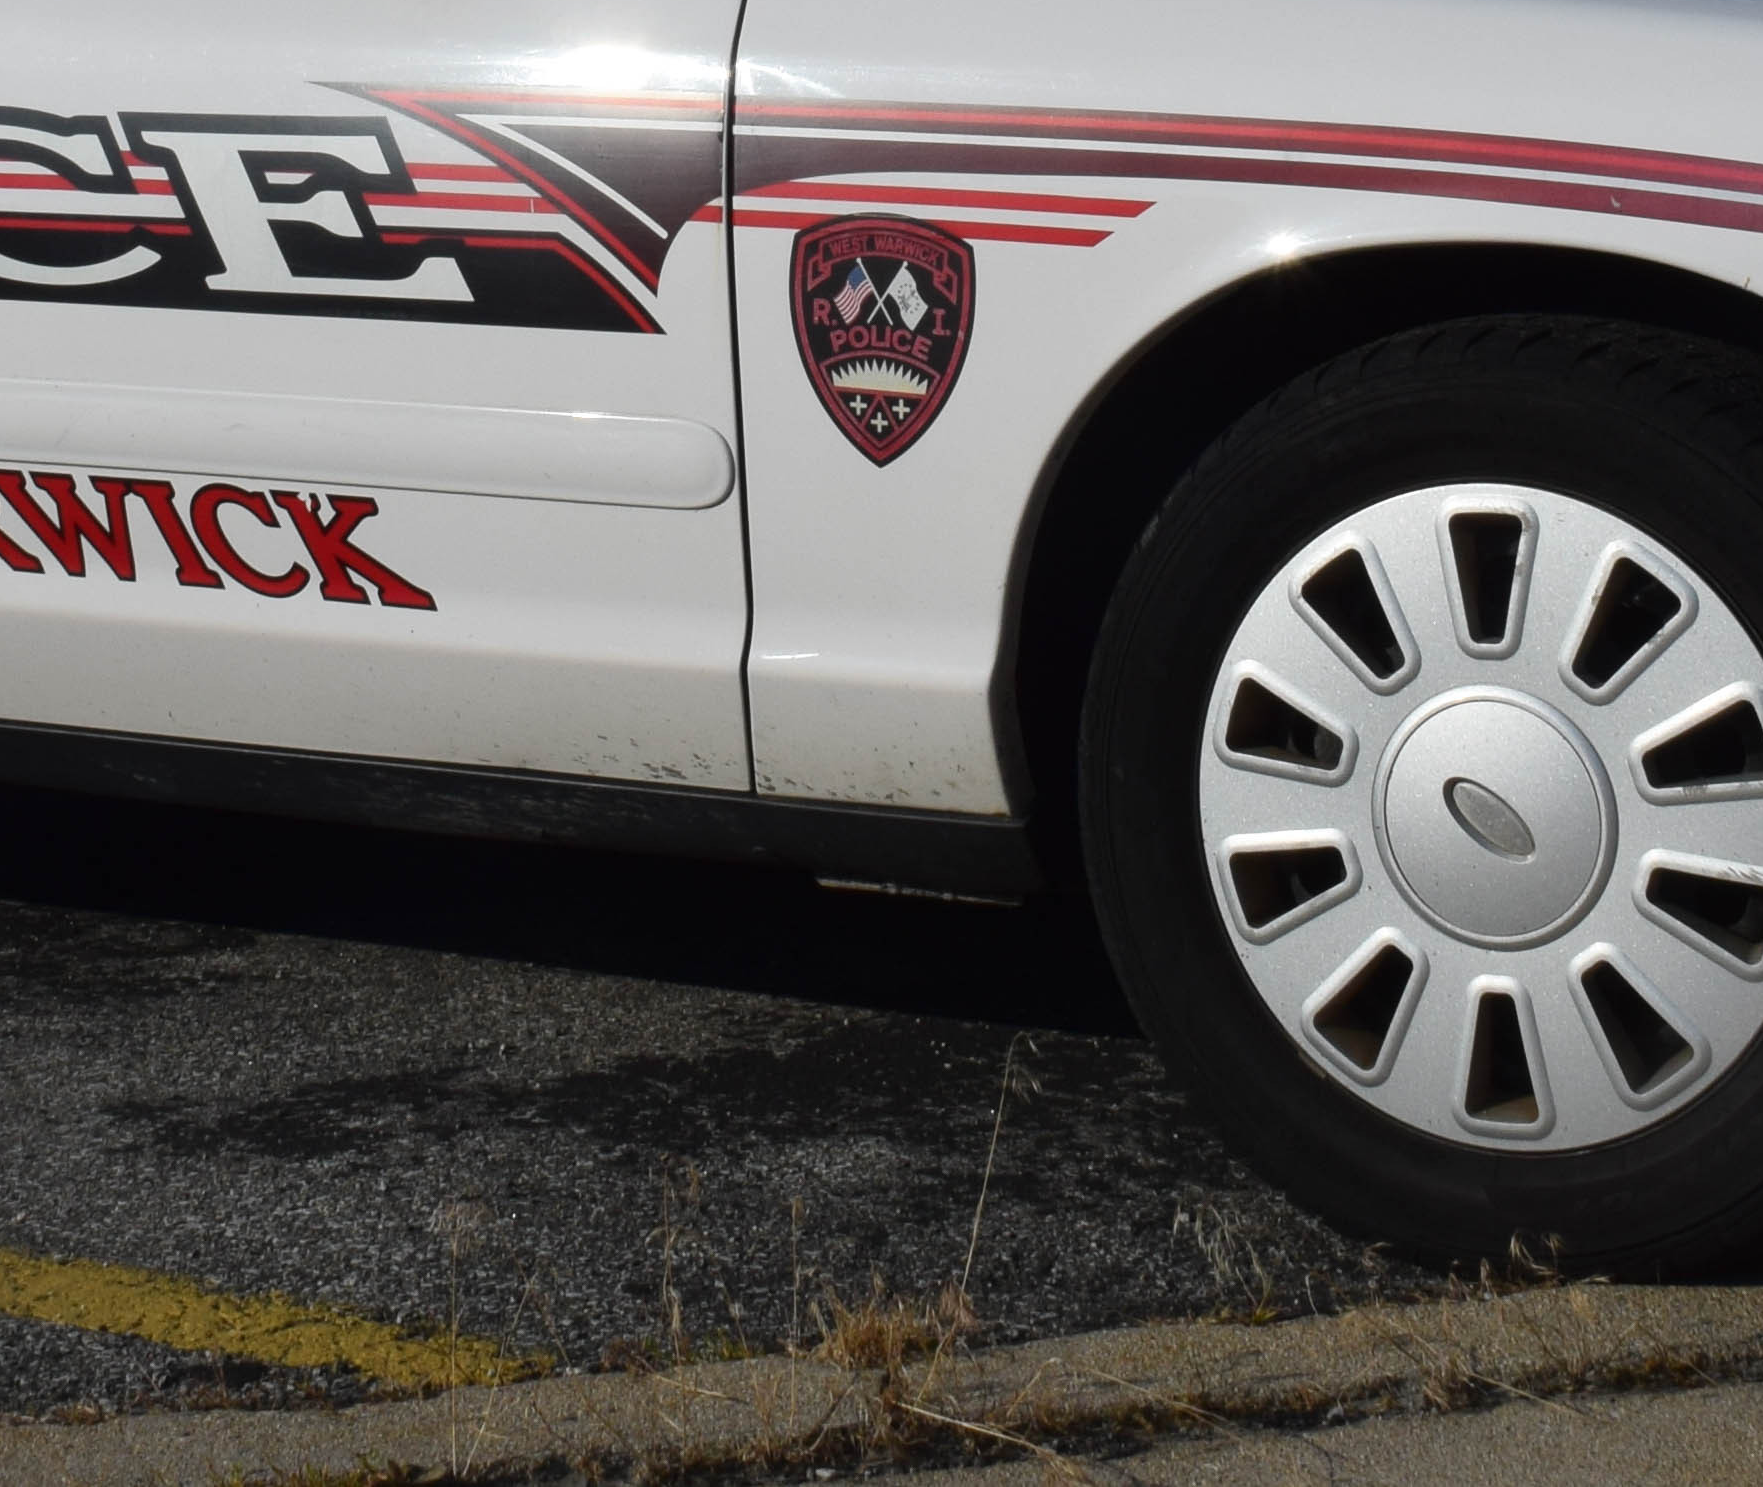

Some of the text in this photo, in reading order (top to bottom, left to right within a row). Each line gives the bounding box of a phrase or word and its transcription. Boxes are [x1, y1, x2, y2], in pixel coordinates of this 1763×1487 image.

[829, 235, 941, 265] WEST WARWICK
[829, 325, 933, 362] POLICE
